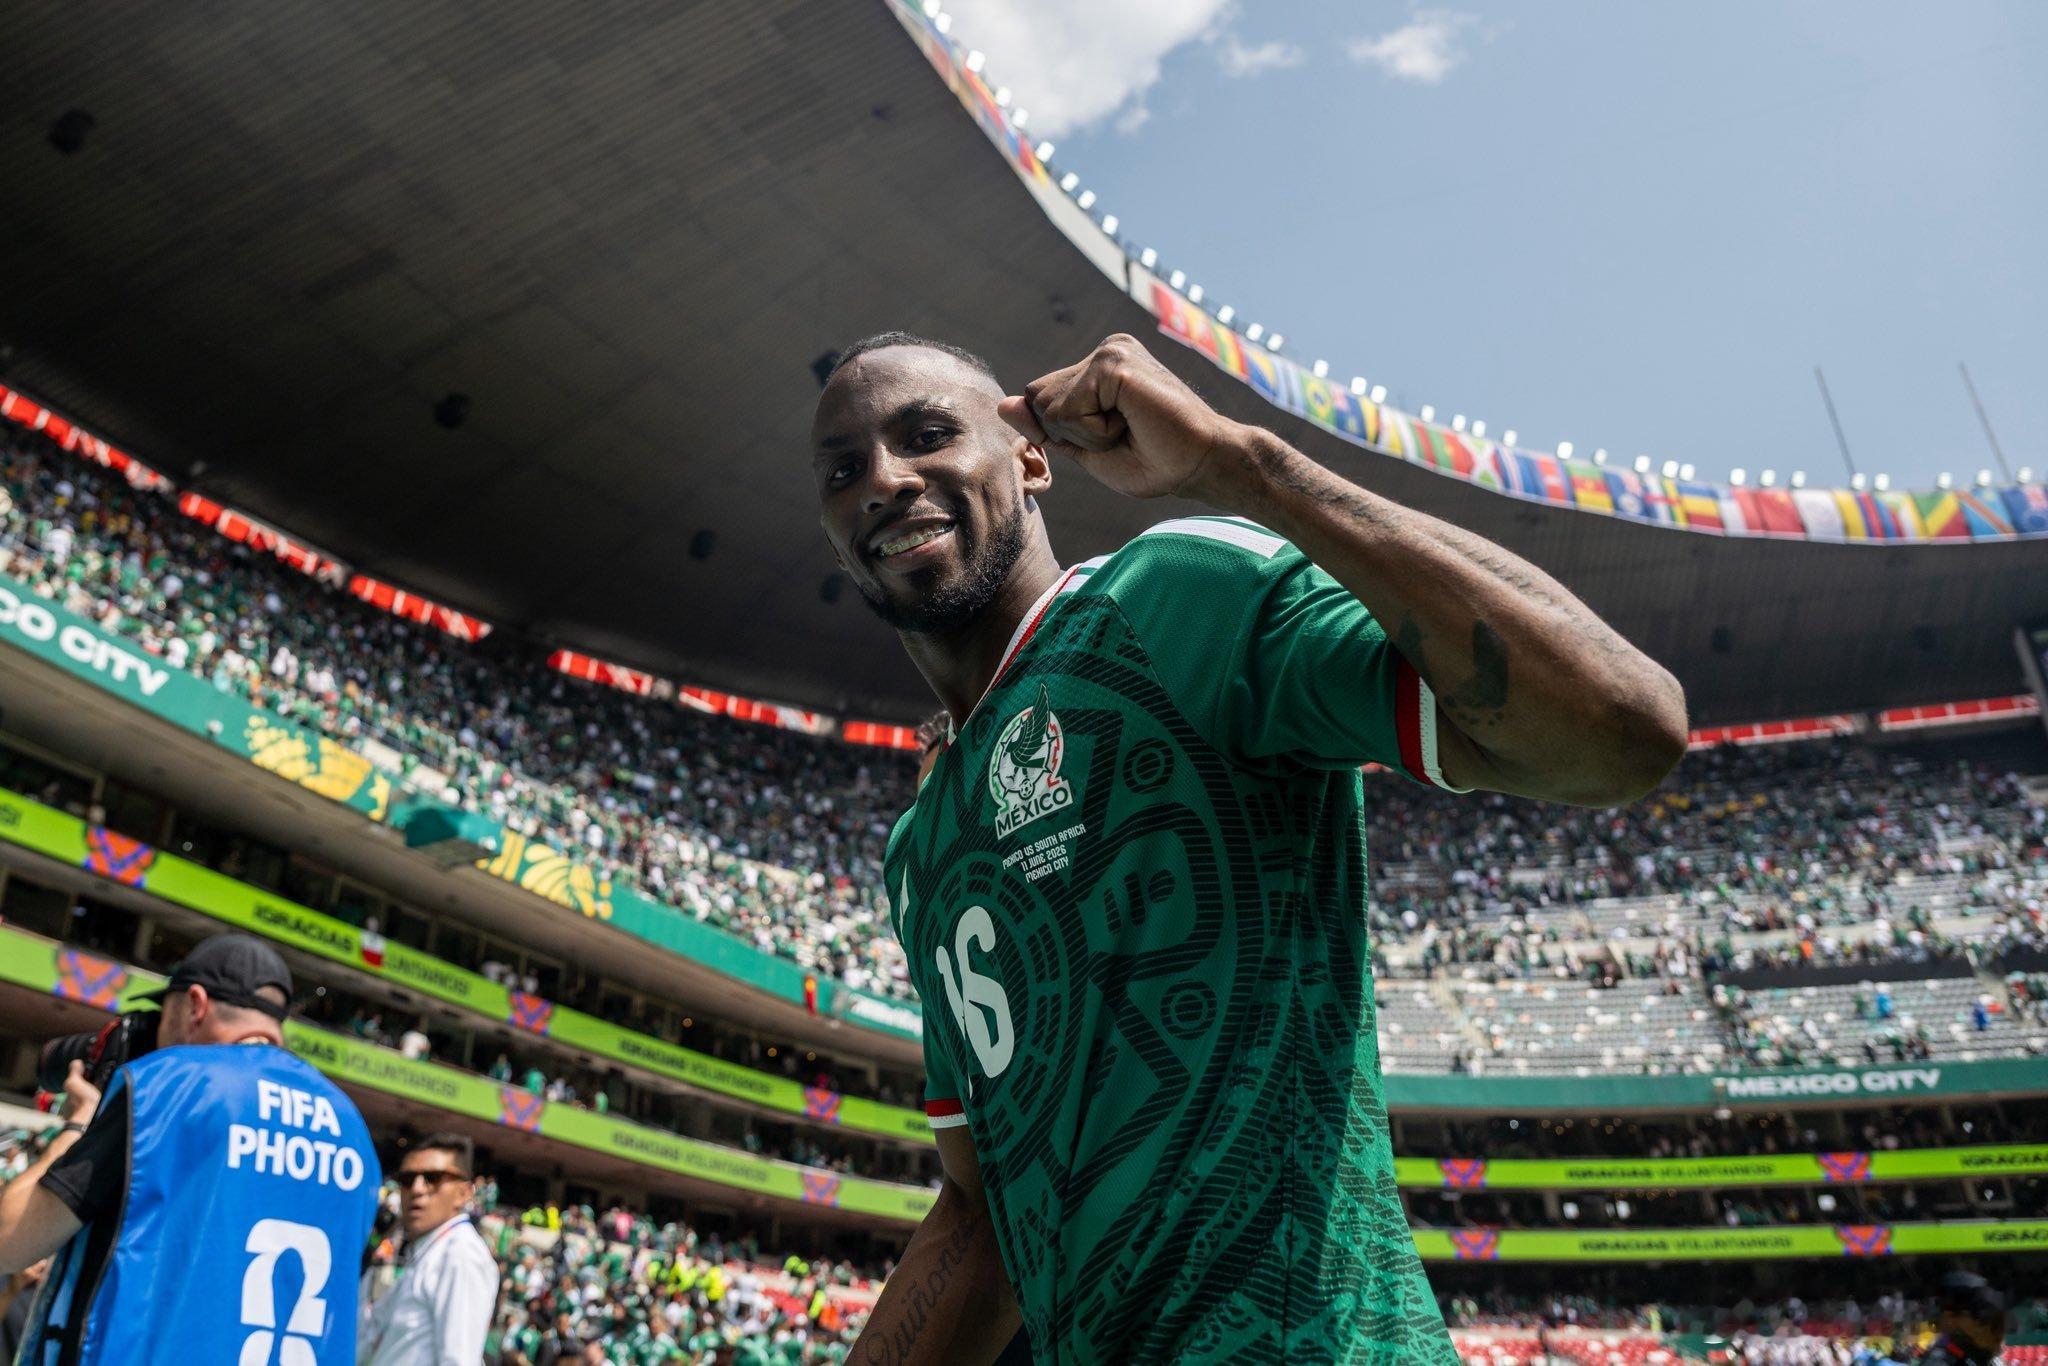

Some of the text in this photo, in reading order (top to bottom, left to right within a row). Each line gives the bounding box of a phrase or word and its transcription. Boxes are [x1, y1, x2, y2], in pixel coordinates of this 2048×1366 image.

[59, 625, 170, 696] CITY
[996, 787, 1069, 836] MÉXICO
[1002, 849, 1023, 870] MEXICO
[1034, 834, 1059, 852] SOUTH
[1058, 823, 1086, 842] AFRICA
[1020, 844, 1067, 872] 11 JUNE 2026
[1025, 856, 1069, 883] MEXICO CITY
[935, 905, 1015, 1079] 16
[1727, 1068, 1942, 1097] MEXICO CITY
[257, 1079, 342, 1137] FIFA
[227, 1123, 364, 1192] PHOTO
